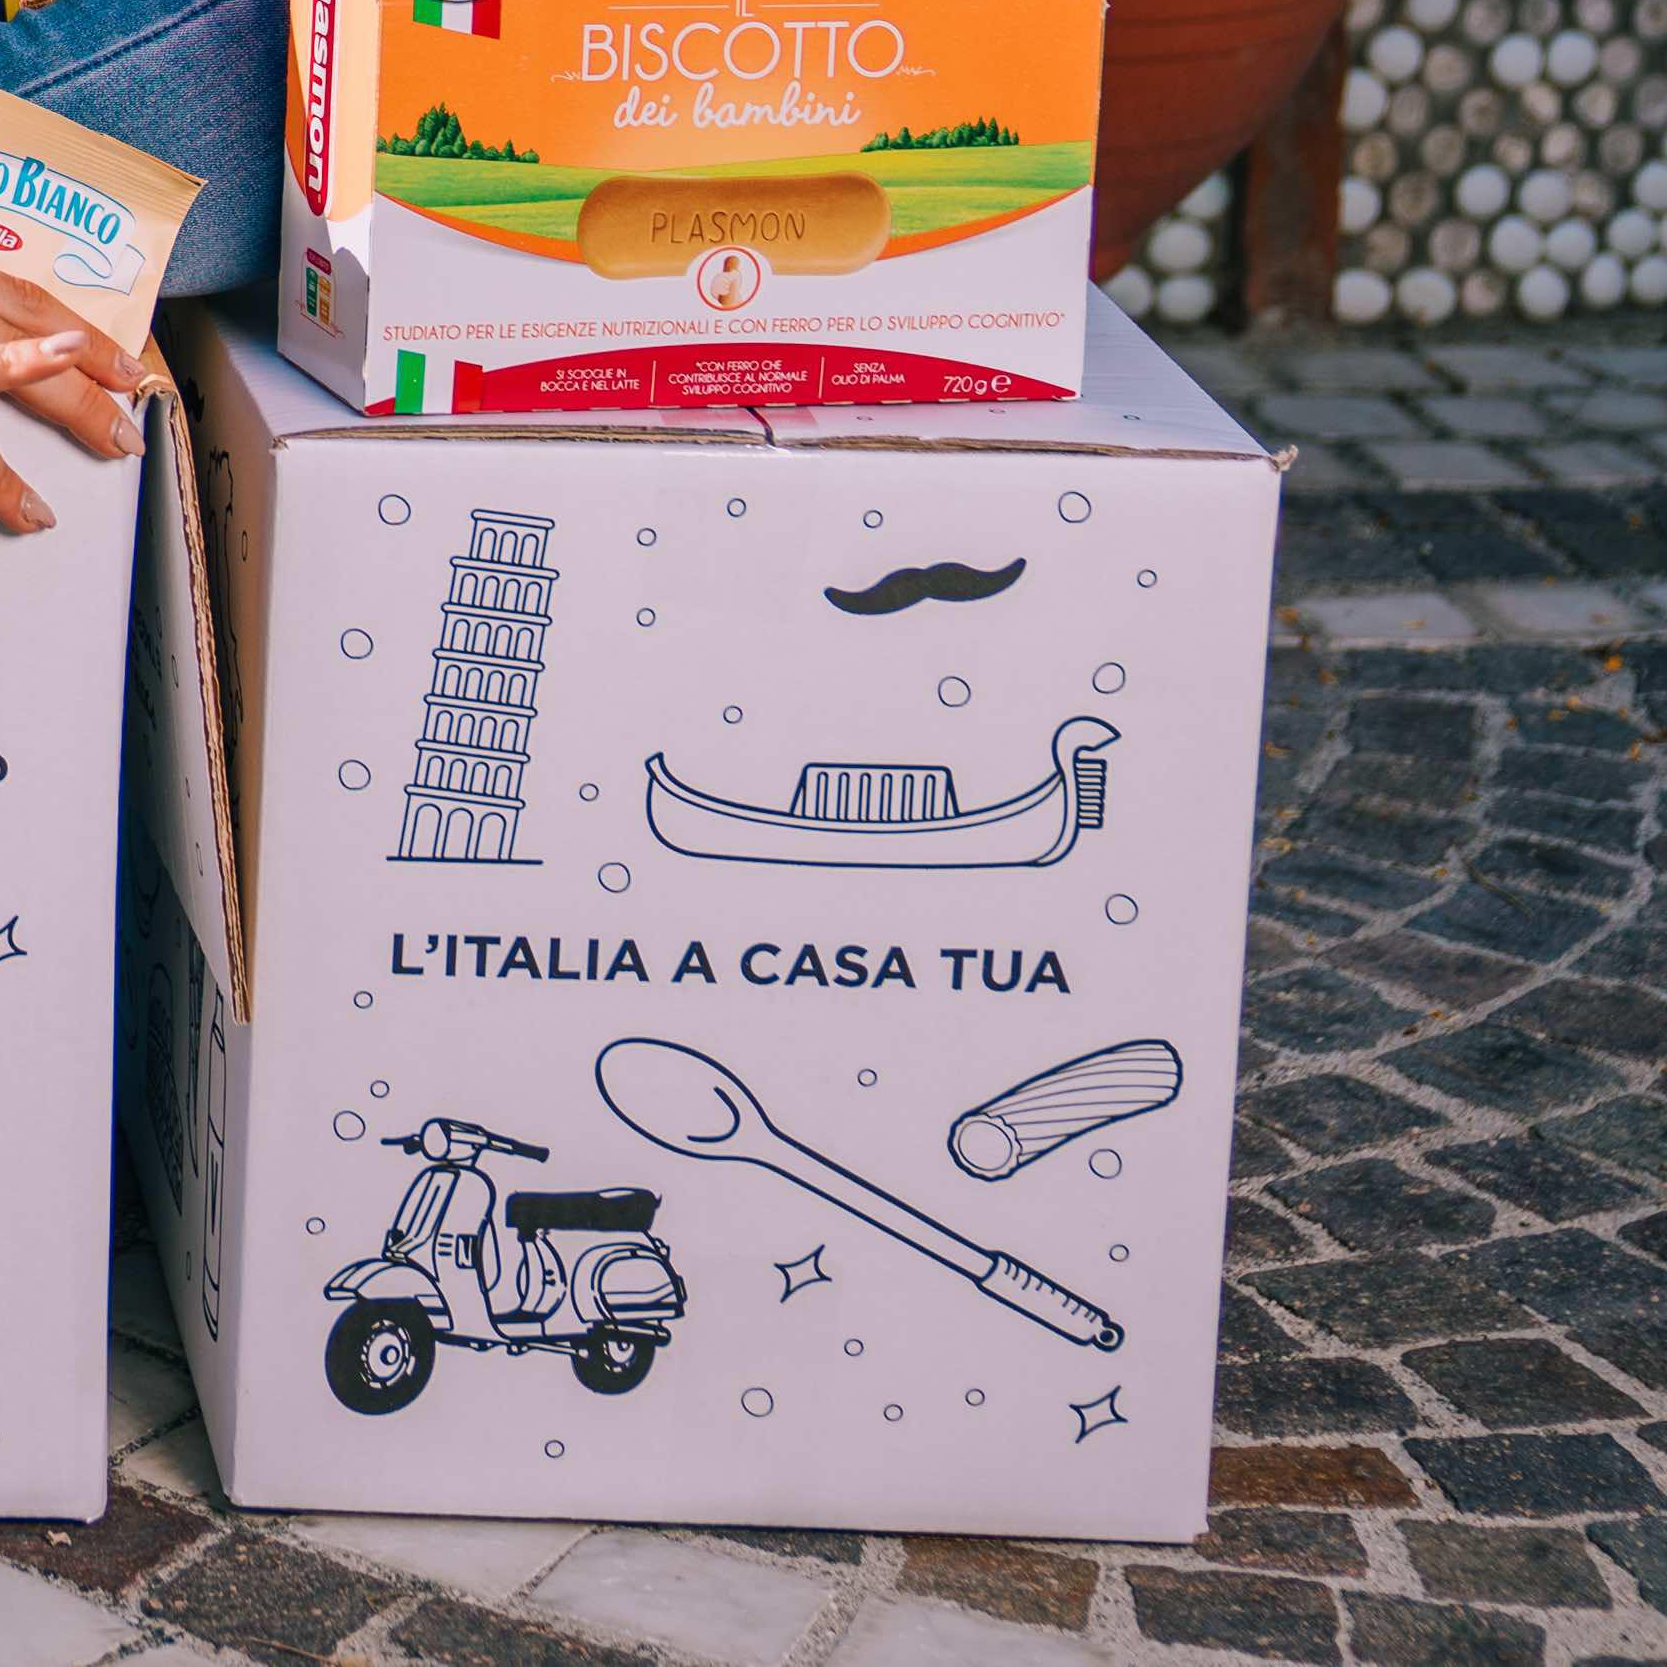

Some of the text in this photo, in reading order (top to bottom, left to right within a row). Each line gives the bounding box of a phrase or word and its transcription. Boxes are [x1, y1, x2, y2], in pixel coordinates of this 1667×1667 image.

[580, 19, 905, 82] BISCOTTO
[612, 81, 861, 129] dei bambini
[11, 155, 122, 246] BIANCO
[650, 211, 806, 244] PLASMON
[382, 324, 462, 341] STUDIATO
[466, 323, 495, 340] PER
[499, 323, 516, 339] LE
[521, 321, 596, 339] ESIGENZE
[602, 319, 712, 337] NUTRIZIONALI
[715, 318, 724, 333] E
[728, 317, 767, 334] CON
[771, 316, 823, 333] FERRO
[826, 315, 855, 332] PER
[859, 314, 884, 331] LO
[887, 314, 963, 331] SVILUPPO
[726, 360, 760, 372] FERRO
[761, 359, 783, 371] CHE
[853, 362, 886, 374] SENZA
[539, 380, 580, 392] BOCCA
[590, 379, 609, 391] NEL
[611, 379, 641, 391] LATTE
[668, 372, 741, 384] CONTRIBUISCE
[758, 369, 808, 383] NORMALE
[830, 374, 858, 386] OLIO
[872, 373, 906, 385] PALMA
[681, 382, 793, 396] SVILUPPO COGNITIVO
[391, 932, 1072, 995] L'ITALIA A CASA TUA
